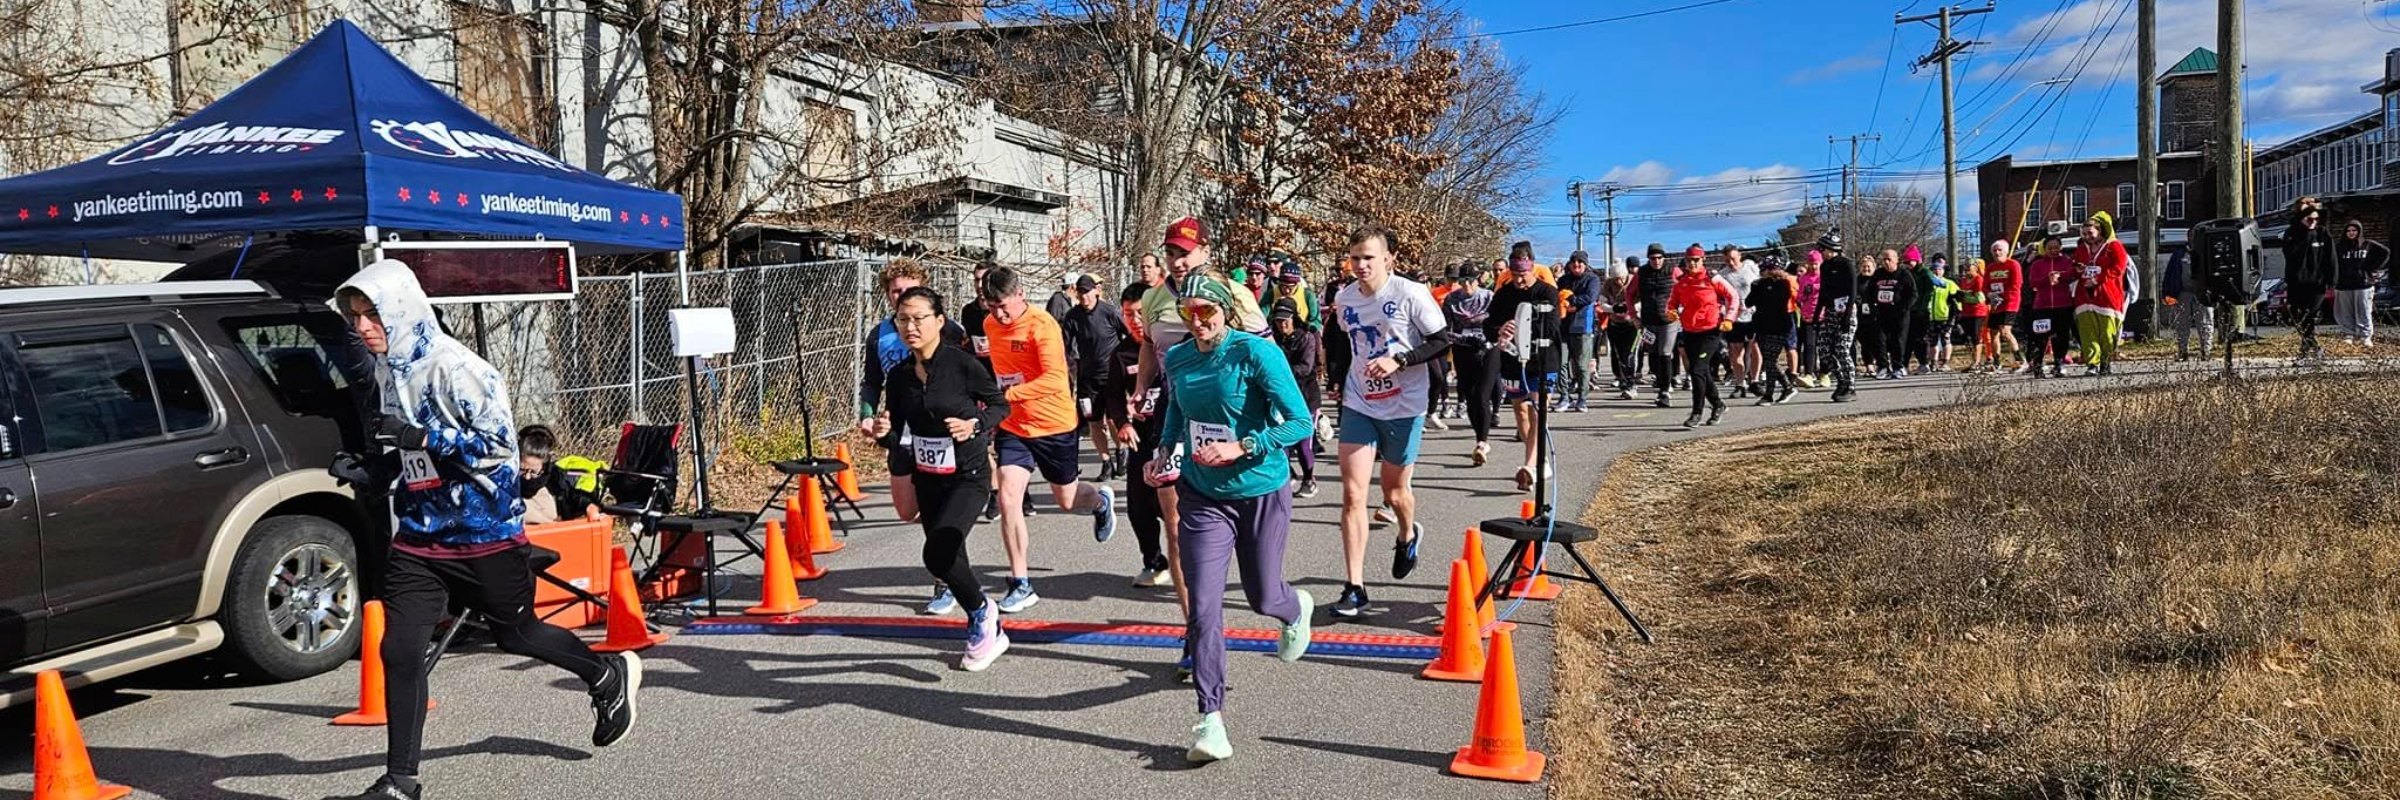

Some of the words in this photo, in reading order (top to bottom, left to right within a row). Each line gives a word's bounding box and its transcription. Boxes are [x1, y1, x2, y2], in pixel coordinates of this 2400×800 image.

[143, 121, 344, 161] YANKEE
[174, 144, 298, 157] TIMING
[73, 189, 243, 222] yankeetiming.com
[481, 192, 612, 222] yankeetiming.com
[1365, 377, 1393, 393] 395
[918, 448, 946, 465] 387
